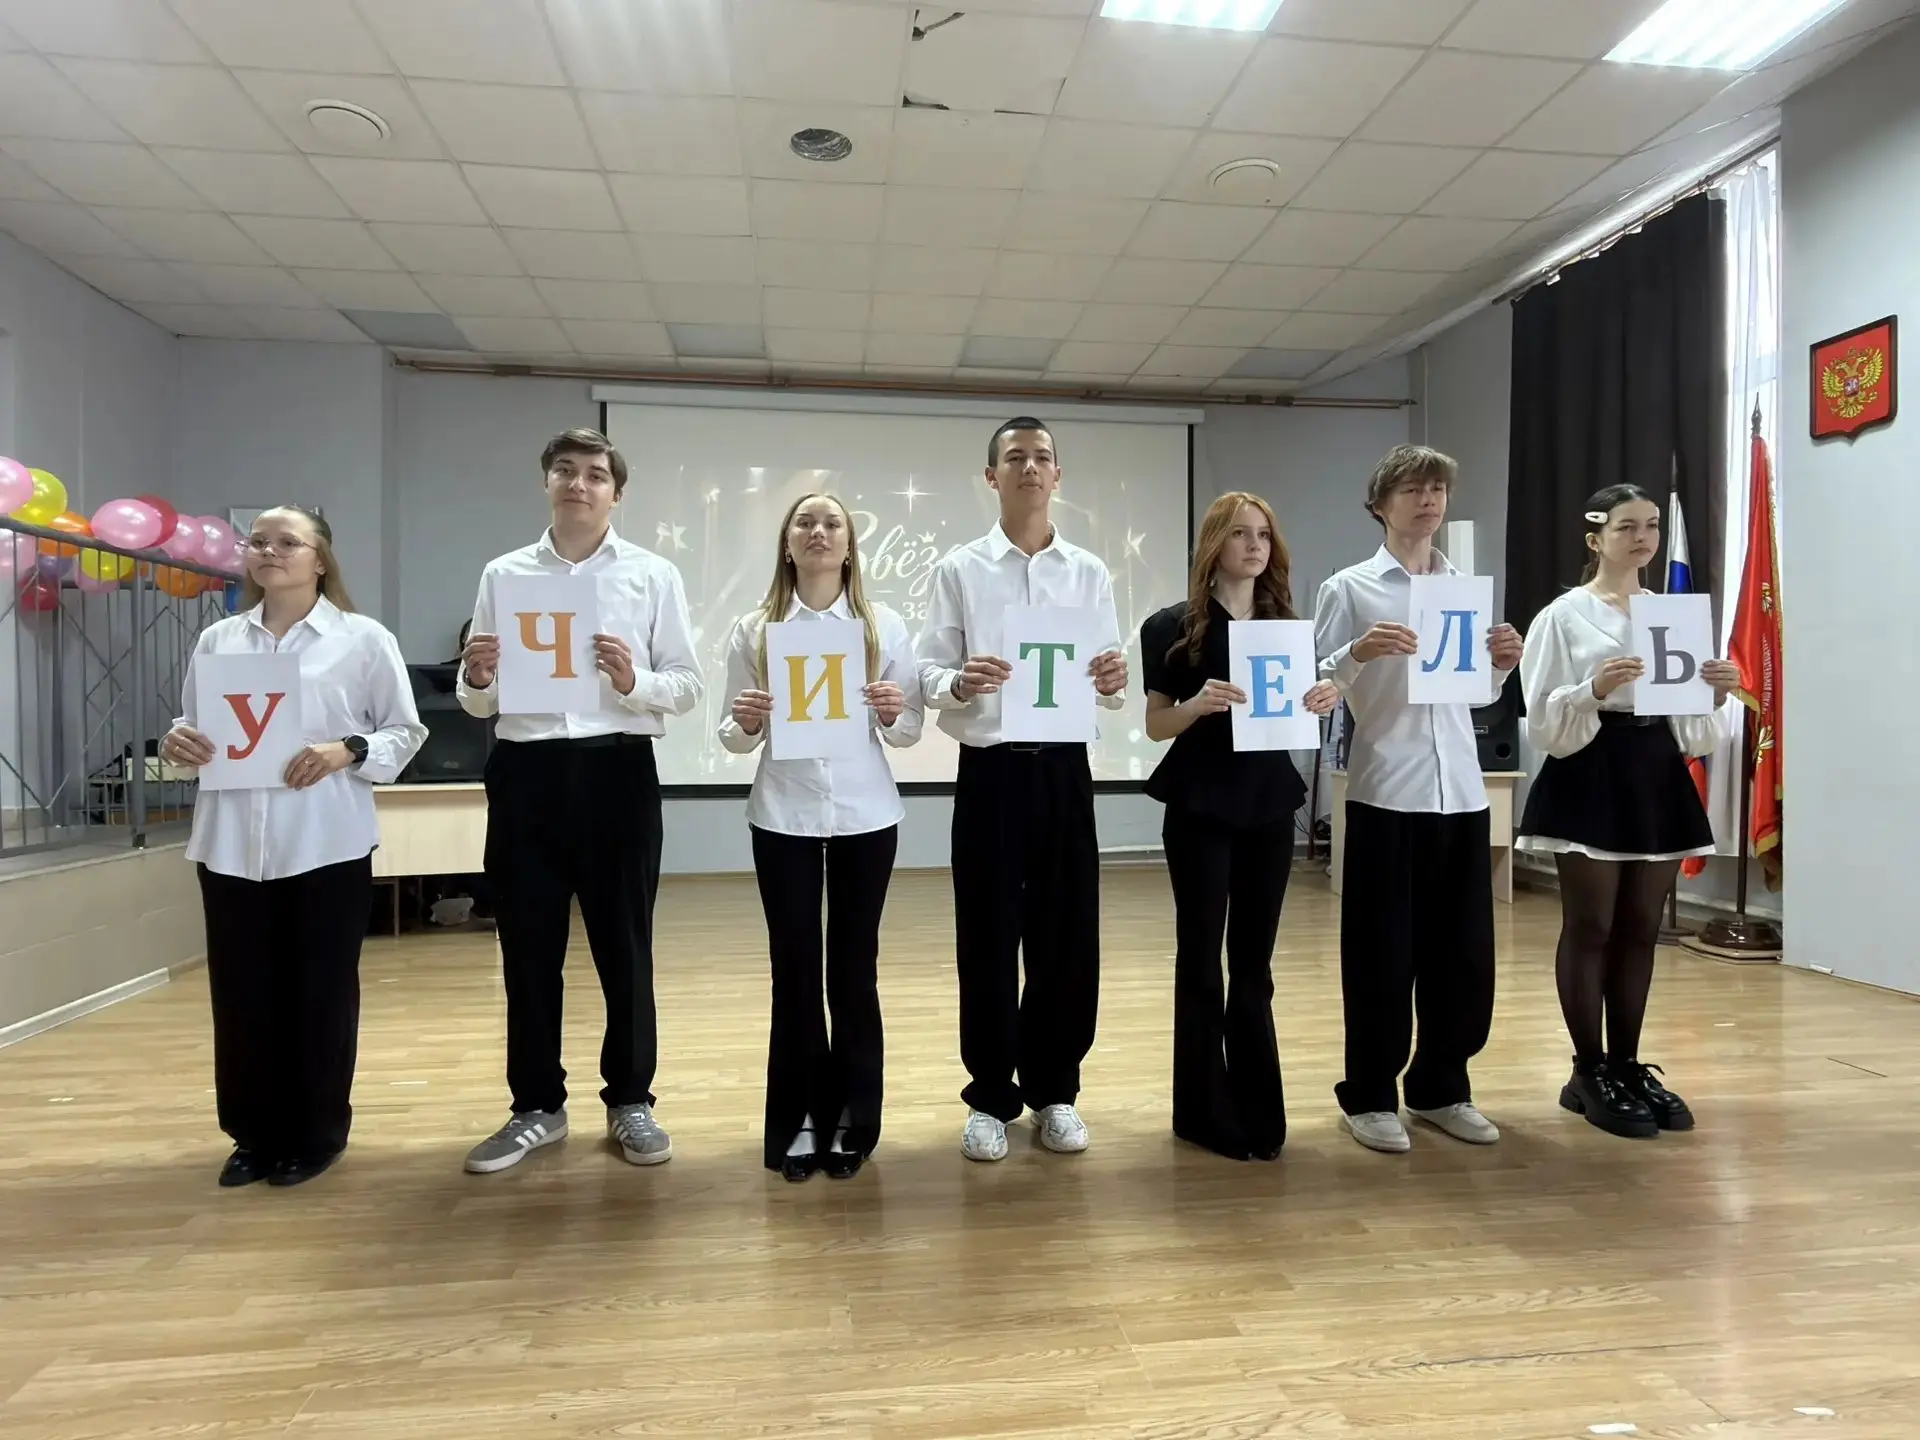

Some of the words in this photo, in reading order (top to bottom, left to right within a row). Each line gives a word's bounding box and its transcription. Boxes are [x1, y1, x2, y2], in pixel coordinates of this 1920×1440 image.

[223, 692, 286, 760] У
[516, 611, 577, 679] Ч
[784, 653, 849, 722] И
[1019, 642, 1075, 708] Т
[1247, 654, 1293, 718] Е
[1422, 609, 1478, 673] Л
[1648, 626, 1696, 685] Ь
